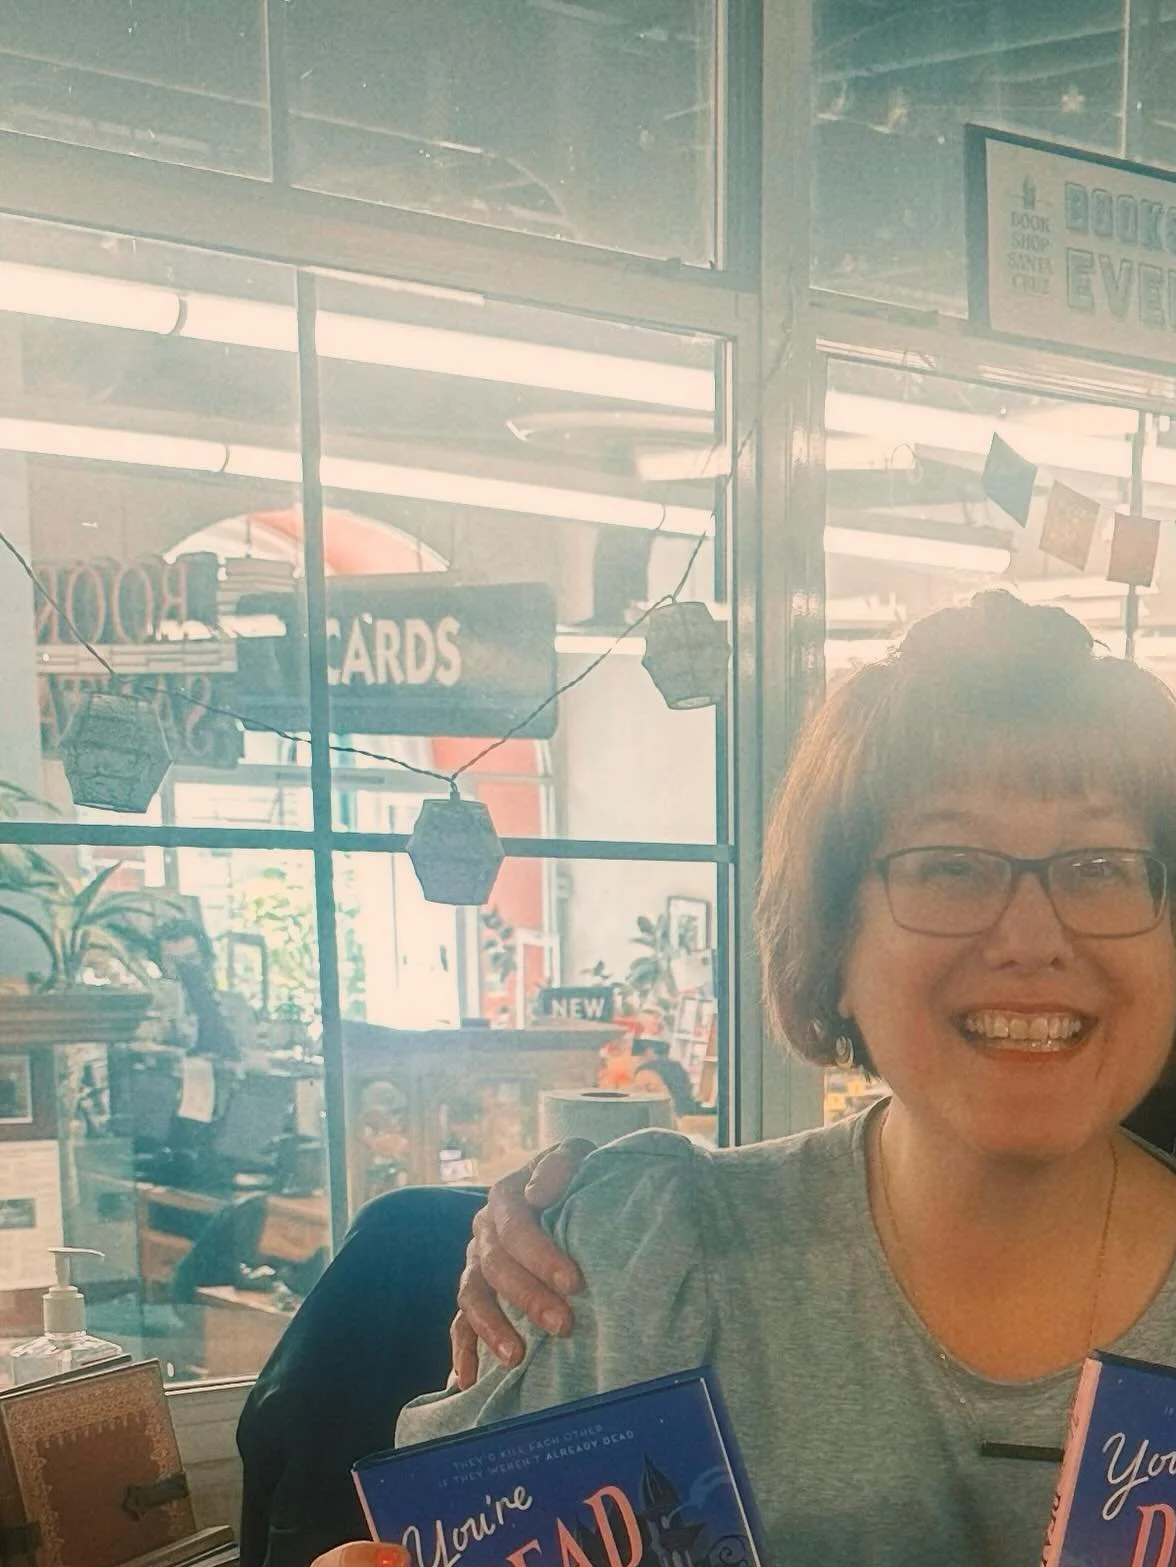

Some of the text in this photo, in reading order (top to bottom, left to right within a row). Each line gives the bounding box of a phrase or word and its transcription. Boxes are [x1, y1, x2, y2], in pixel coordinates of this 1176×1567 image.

[1011, 212, 1051, 233] BOOK
[1011, 232, 1051, 253] SHOP
[326, 615, 462, 686] CARDS
[551, 997, 606, 1018] NEW
[528, 1437, 560, 1451] EACH
[563, 1424, 603, 1441] OTHER
[546, 1440, 599, 1461] ALREADY
[603, 1430, 635, 1446] DEAD
